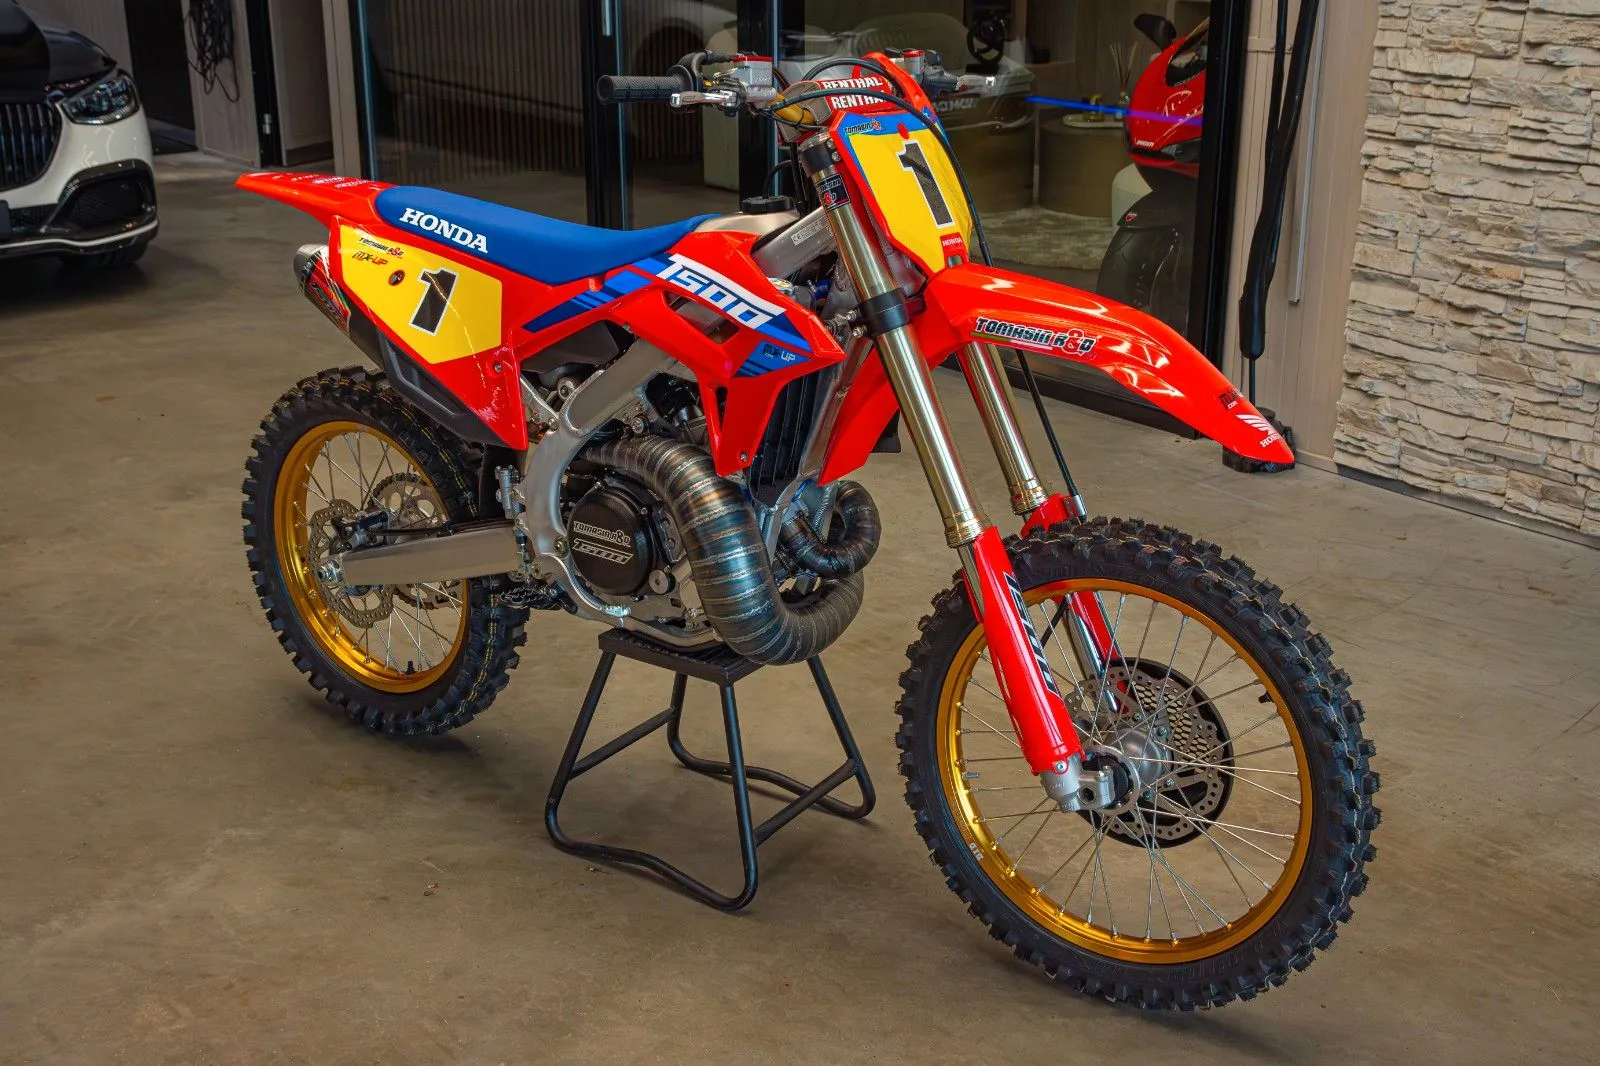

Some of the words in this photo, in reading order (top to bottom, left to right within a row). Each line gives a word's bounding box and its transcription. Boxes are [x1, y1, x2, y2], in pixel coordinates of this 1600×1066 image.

[821, 76, 883, 90] RENTHAL
[831, 94, 886, 109] RENTHA
[896, 140, 955, 229] 1
[399, 207, 488, 254] HONDA
[942, 237, 963, 247] HONDA
[408, 266, 459, 337] 1
[975, 316, 1053, 346] TOMASIN
[1052, 328, 1097, 356] R&D
[573, 520, 612, 540] TOMASIN
